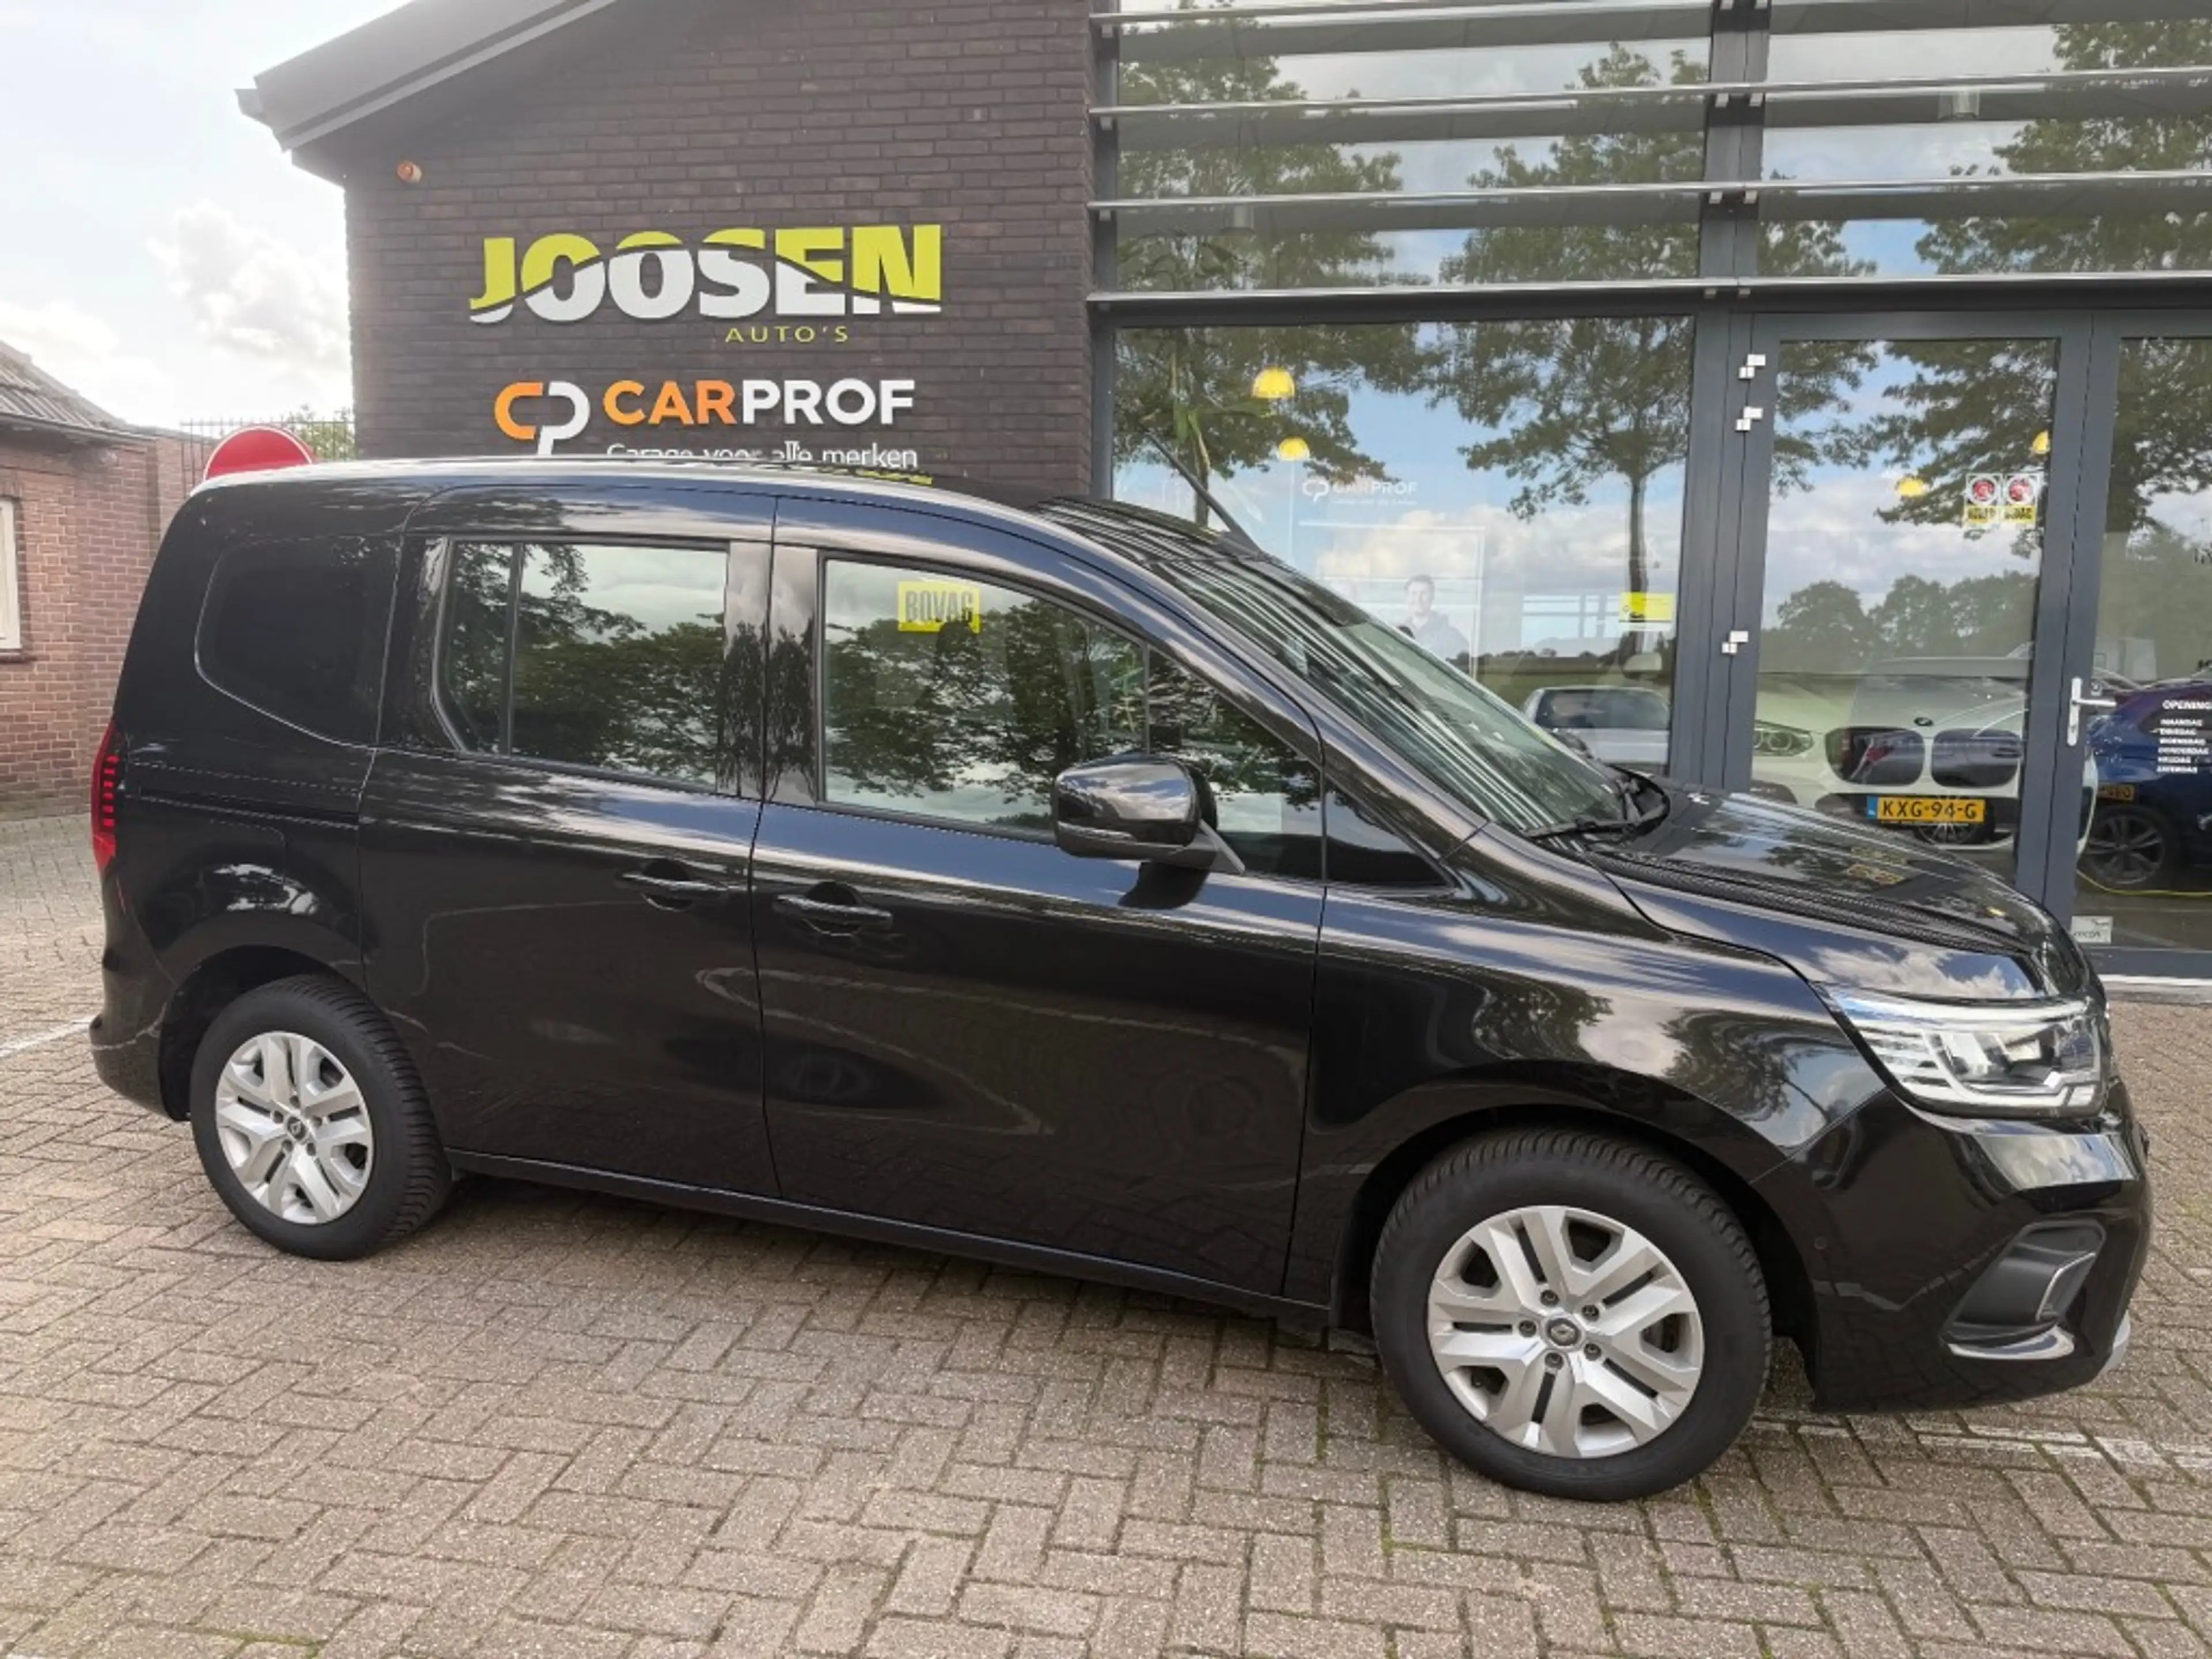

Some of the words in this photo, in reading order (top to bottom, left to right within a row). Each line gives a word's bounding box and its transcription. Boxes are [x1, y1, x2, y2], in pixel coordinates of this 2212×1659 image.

[469, 224, 942, 323] JOOSEN
[725, 325, 850, 343] AUTO'S
[603, 378, 916, 426] CARPROF
[822, 442, 918, 469] merken
[905, 589, 974, 624] BOVAG
[1883, 801, 1977, 819] KXG-94-G
